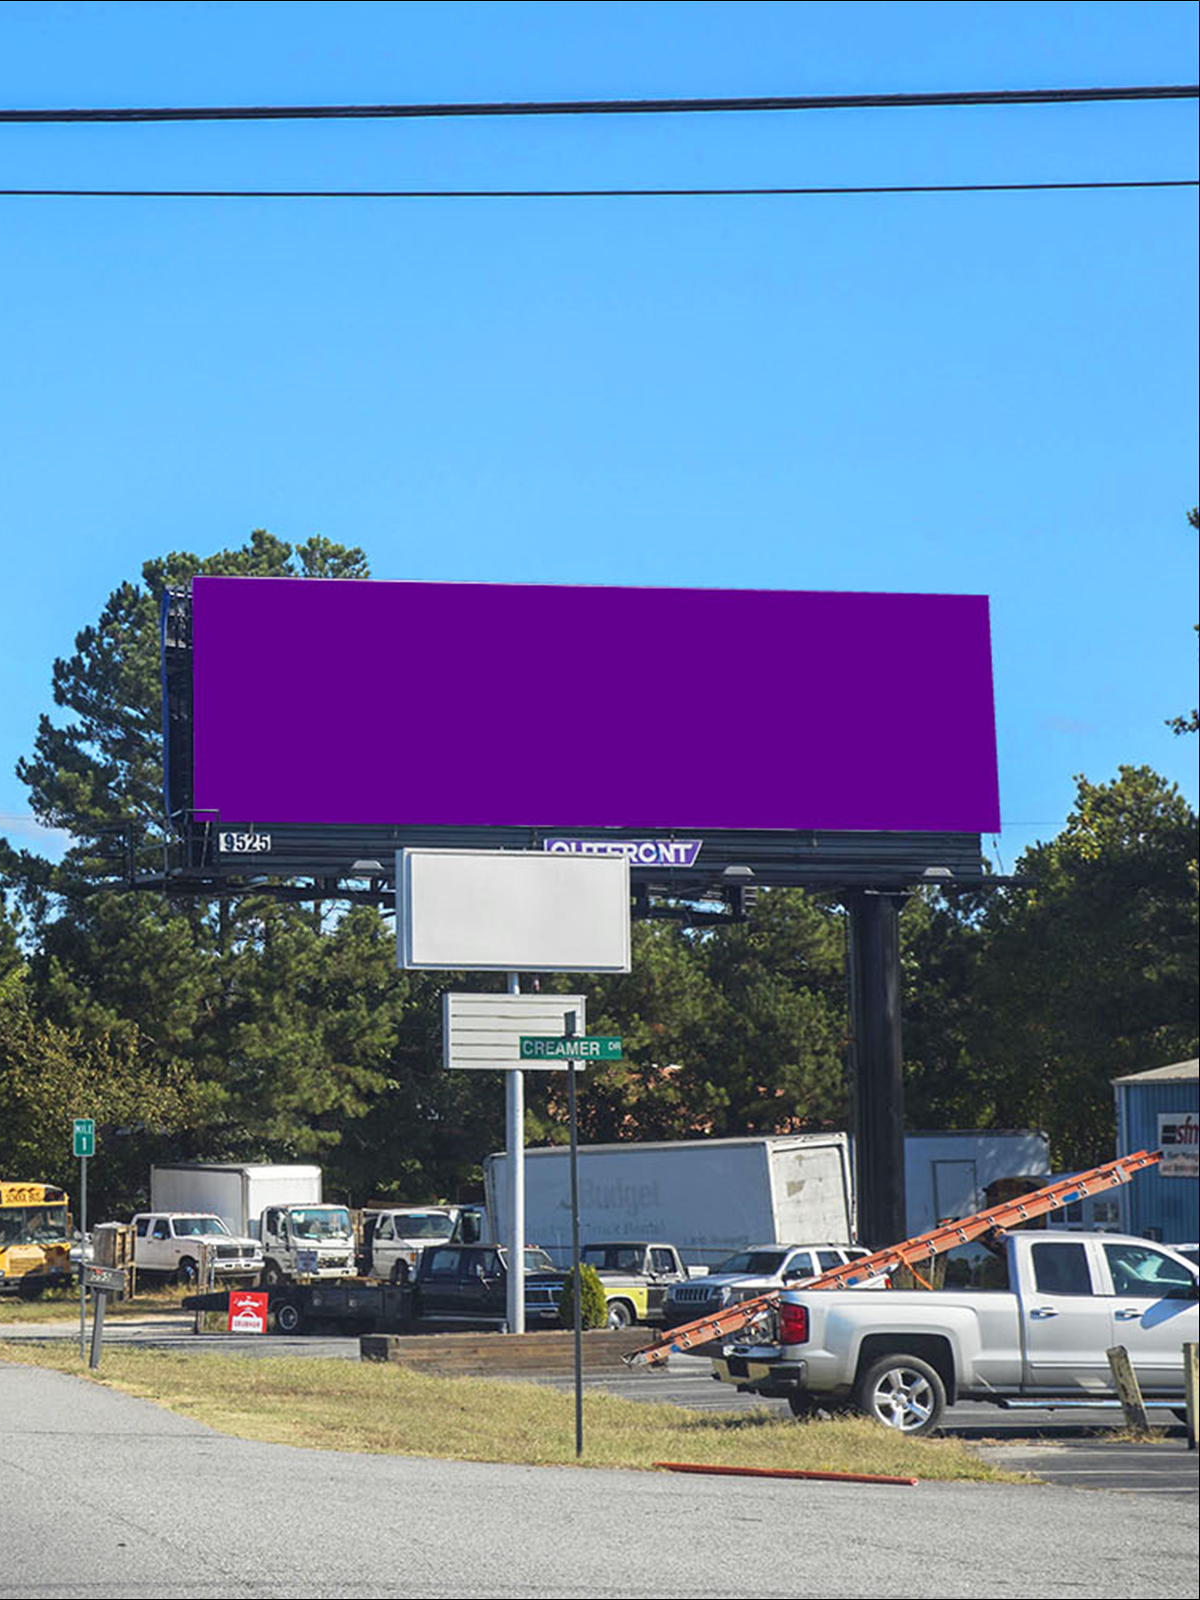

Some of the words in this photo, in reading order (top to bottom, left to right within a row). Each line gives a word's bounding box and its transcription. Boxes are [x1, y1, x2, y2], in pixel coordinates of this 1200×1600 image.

[224, 833, 269, 851] 9525
[522, 1040, 599, 1056] CREAMER
[608, 1041, 621, 1051] DR
